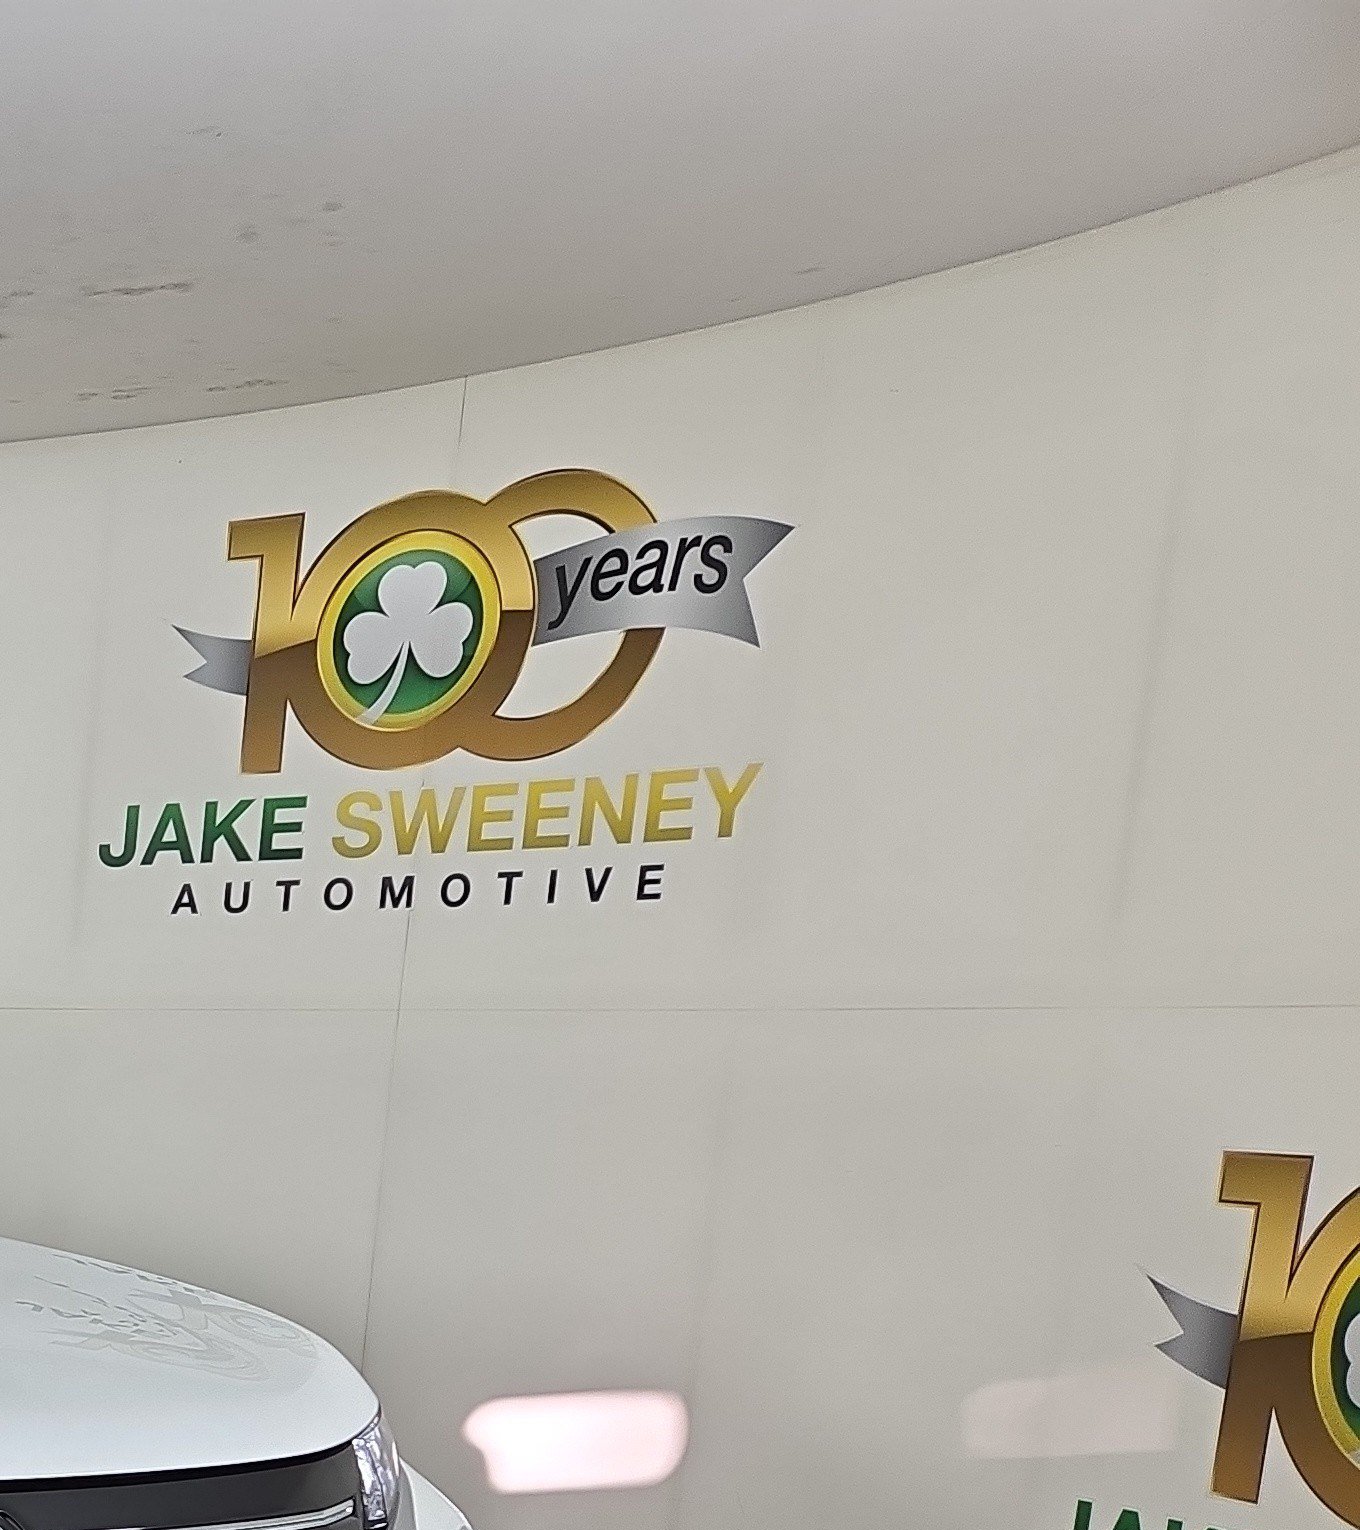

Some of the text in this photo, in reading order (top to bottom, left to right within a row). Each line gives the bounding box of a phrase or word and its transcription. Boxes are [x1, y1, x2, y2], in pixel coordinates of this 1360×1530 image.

[227, 468, 733, 775] 100 years
[98, 763, 764, 868] JAKE SWEENEY
[171, 863, 666, 915] AUTOMOTIVE
